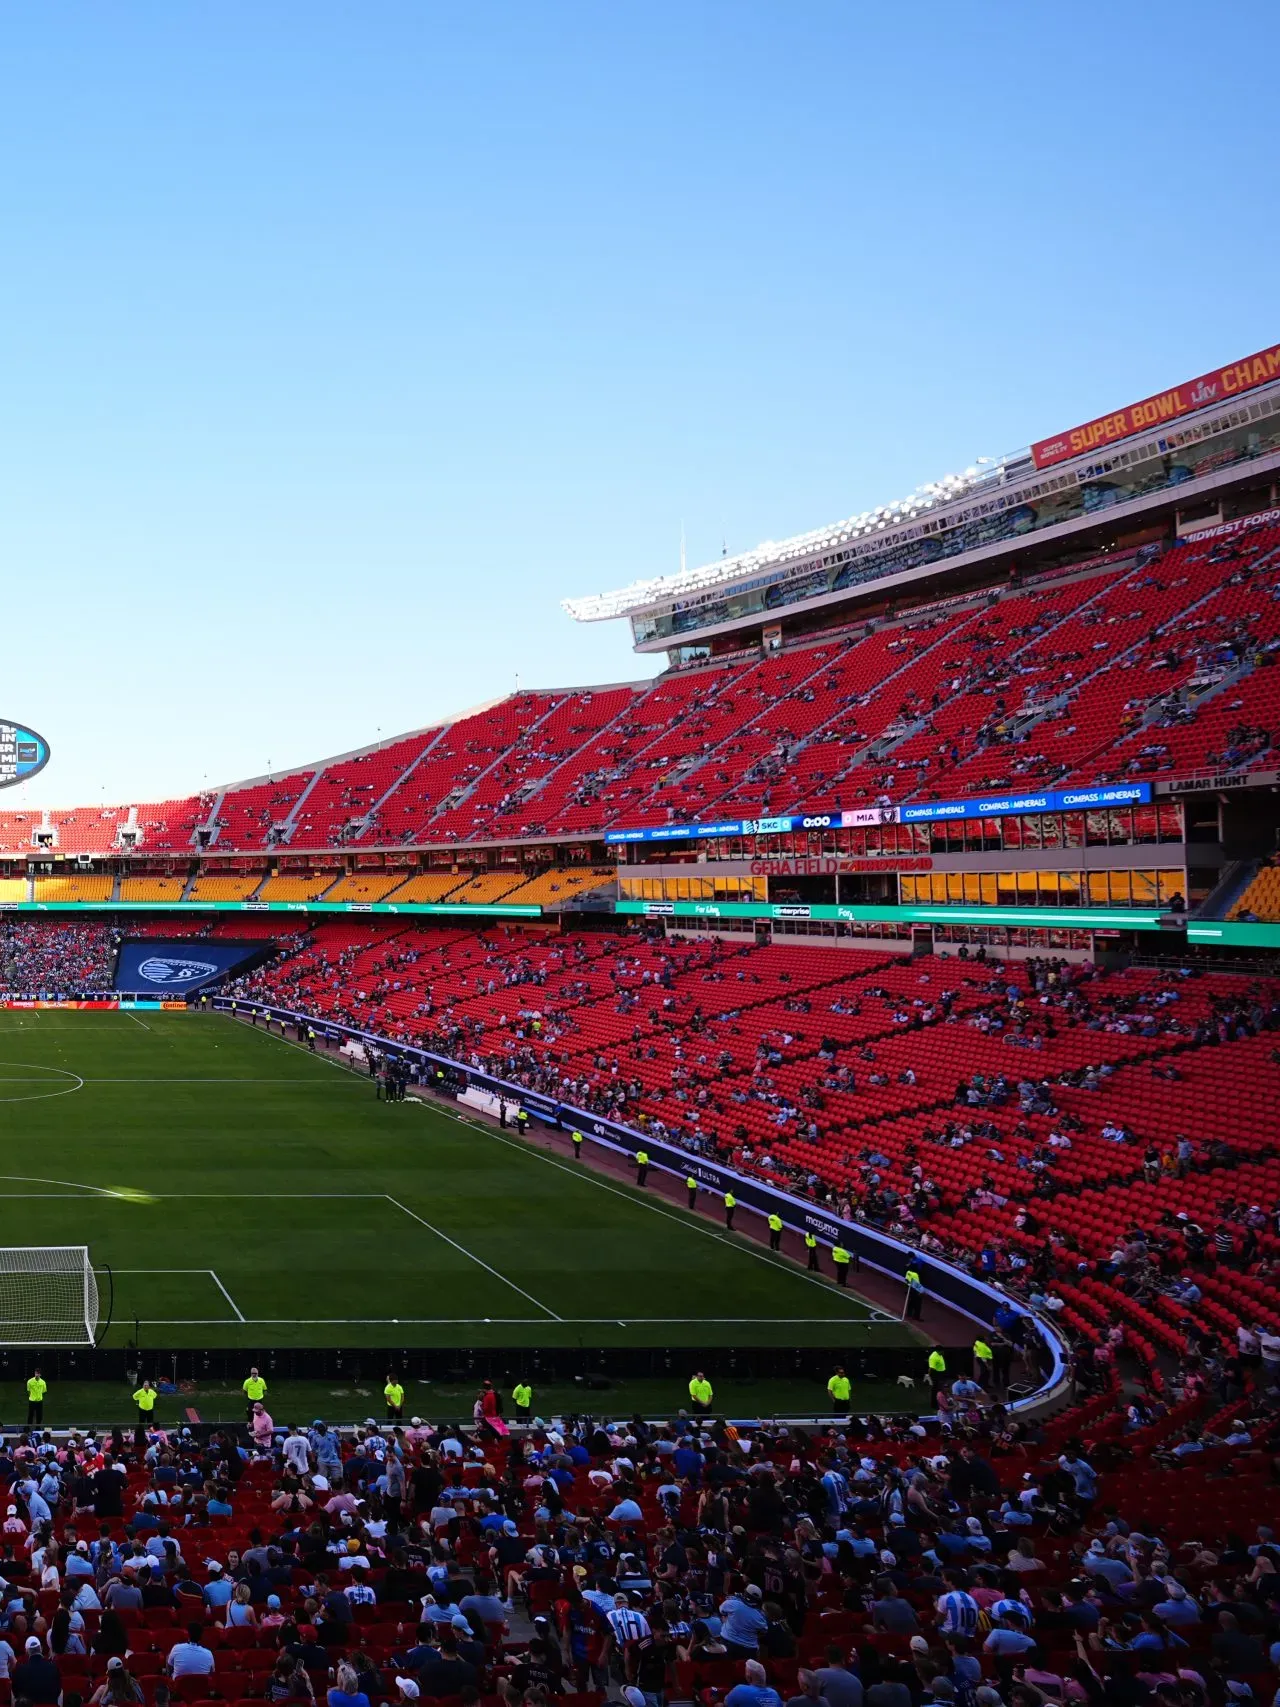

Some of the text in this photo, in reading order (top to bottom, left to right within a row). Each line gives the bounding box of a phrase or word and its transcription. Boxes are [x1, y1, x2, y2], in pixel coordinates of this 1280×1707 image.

[1070, 416, 1128, 451] SUPER
[1130, 391, 1187, 429] BOWL
[1169, 774, 1249, 792] LAMAR HUNT
[1063, 788, 1141, 806] COMPASS MINERALS
[905, 804, 965, 818] COMPASS MINERALS
[978, 798, 1047, 812] COMPASS MINERALS
[761, 820, 778, 830] SKC
[803, 815, 831, 828] 0:00
[856, 814, 874, 822] MIA
[750, 860, 792, 875] GEHA
[794, 857, 838, 874] FIELD
[644, 904, 673, 913] enterprise
[775, 906, 810, 916] enterprise
[702, 1170, 720, 1185] ULTRA
[805, 1214, 839, 1236] mazuma
